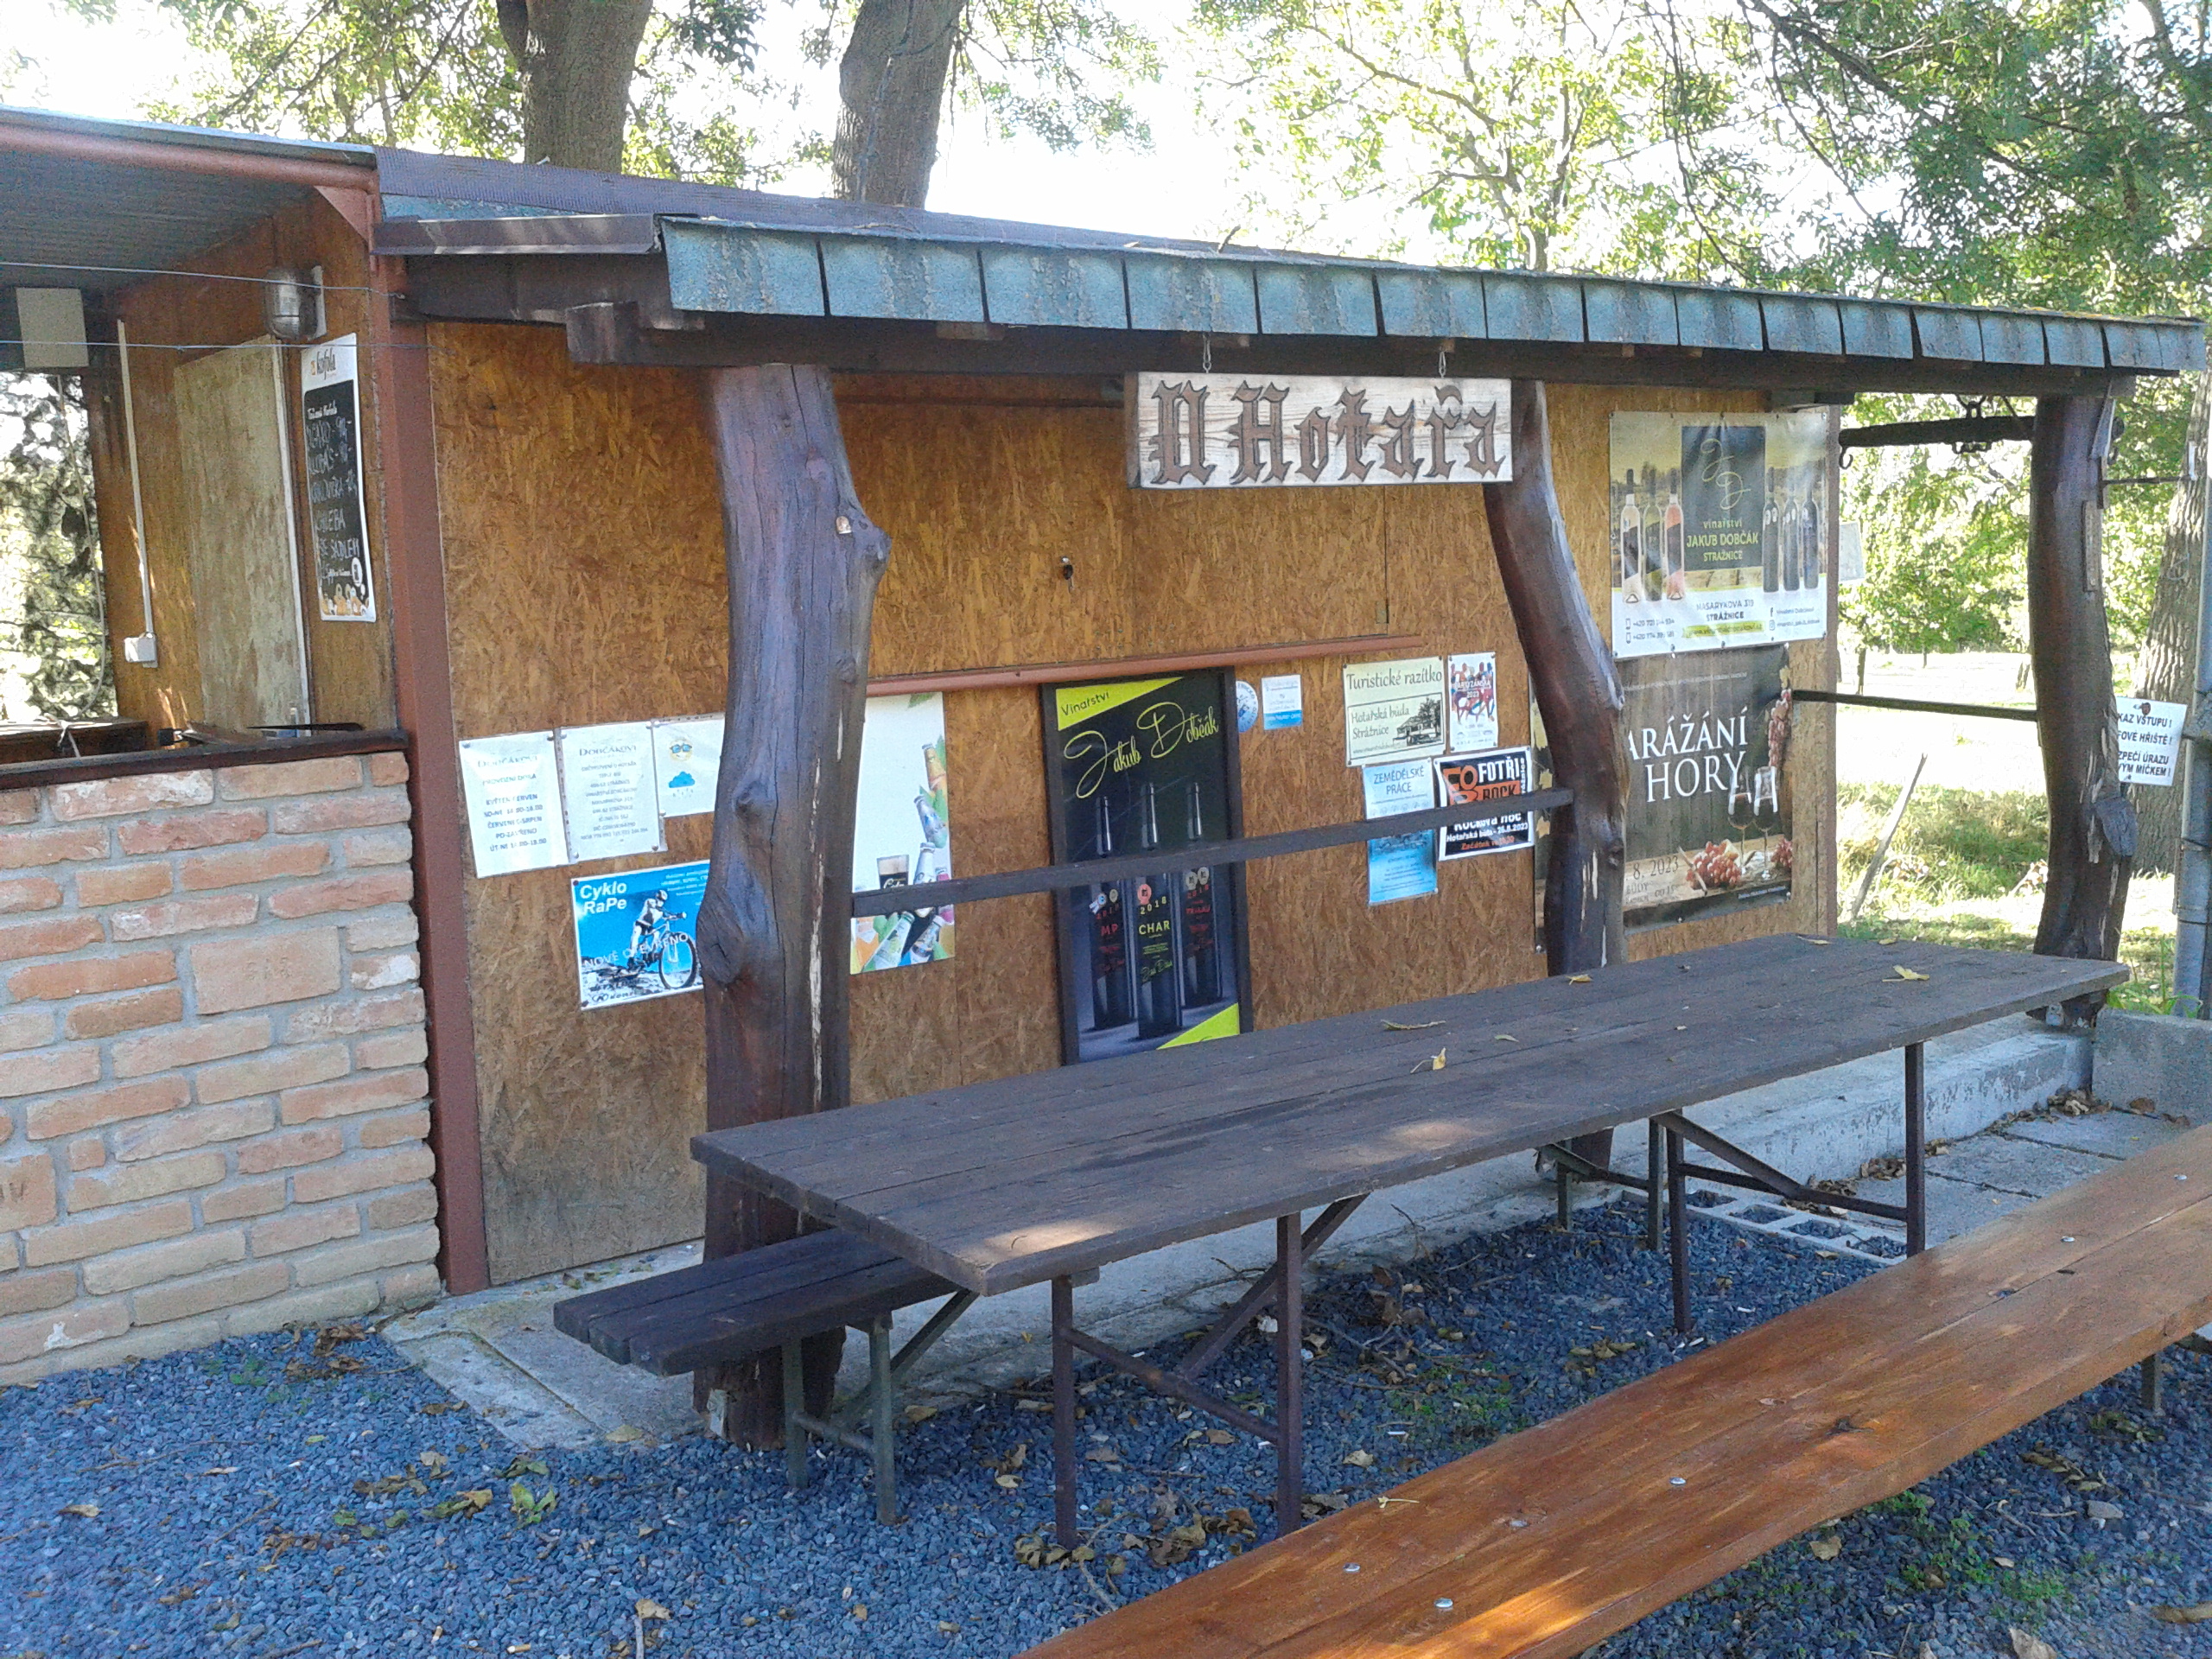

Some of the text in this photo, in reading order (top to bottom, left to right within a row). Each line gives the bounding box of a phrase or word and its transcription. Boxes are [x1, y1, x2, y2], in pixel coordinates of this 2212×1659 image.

[1687, 530, 1758, 548] JAKUB DOBČÁK
[1346, 664, 1443, 690] Turistické razítko
[1061, 690, 1110, 717] Vinařství
[1351, 707, 1388, 724] Hotařská
[2136, 715, 2168, 728] VSTUPU
[1352, 725, 1389, 741] Strážnice
[2139, 731, 2168, 745] HŘIŠTĚ
[1064, 730, 1142, 799] Jakub
[2143, 751, 2169, 765] ÚRAZU
[1478, 755, 1520, 784] FOTŘI
[1645, 750, 1746, 802] HORY
[2136, 764, 2166, 776] MÍČKEM
[1386, 781, 1412, 795] PRÁCE
[1650, 855, 1679, 877] 2023
[580, 880, 627, 901] Cyklo
[583, 897, 627, 915] RaPe
[1140, 895, 1166, 915] 2018
[1138, 920, 1170, 936] CHAR
[622, 933, 690, 958] OEVŘENO
